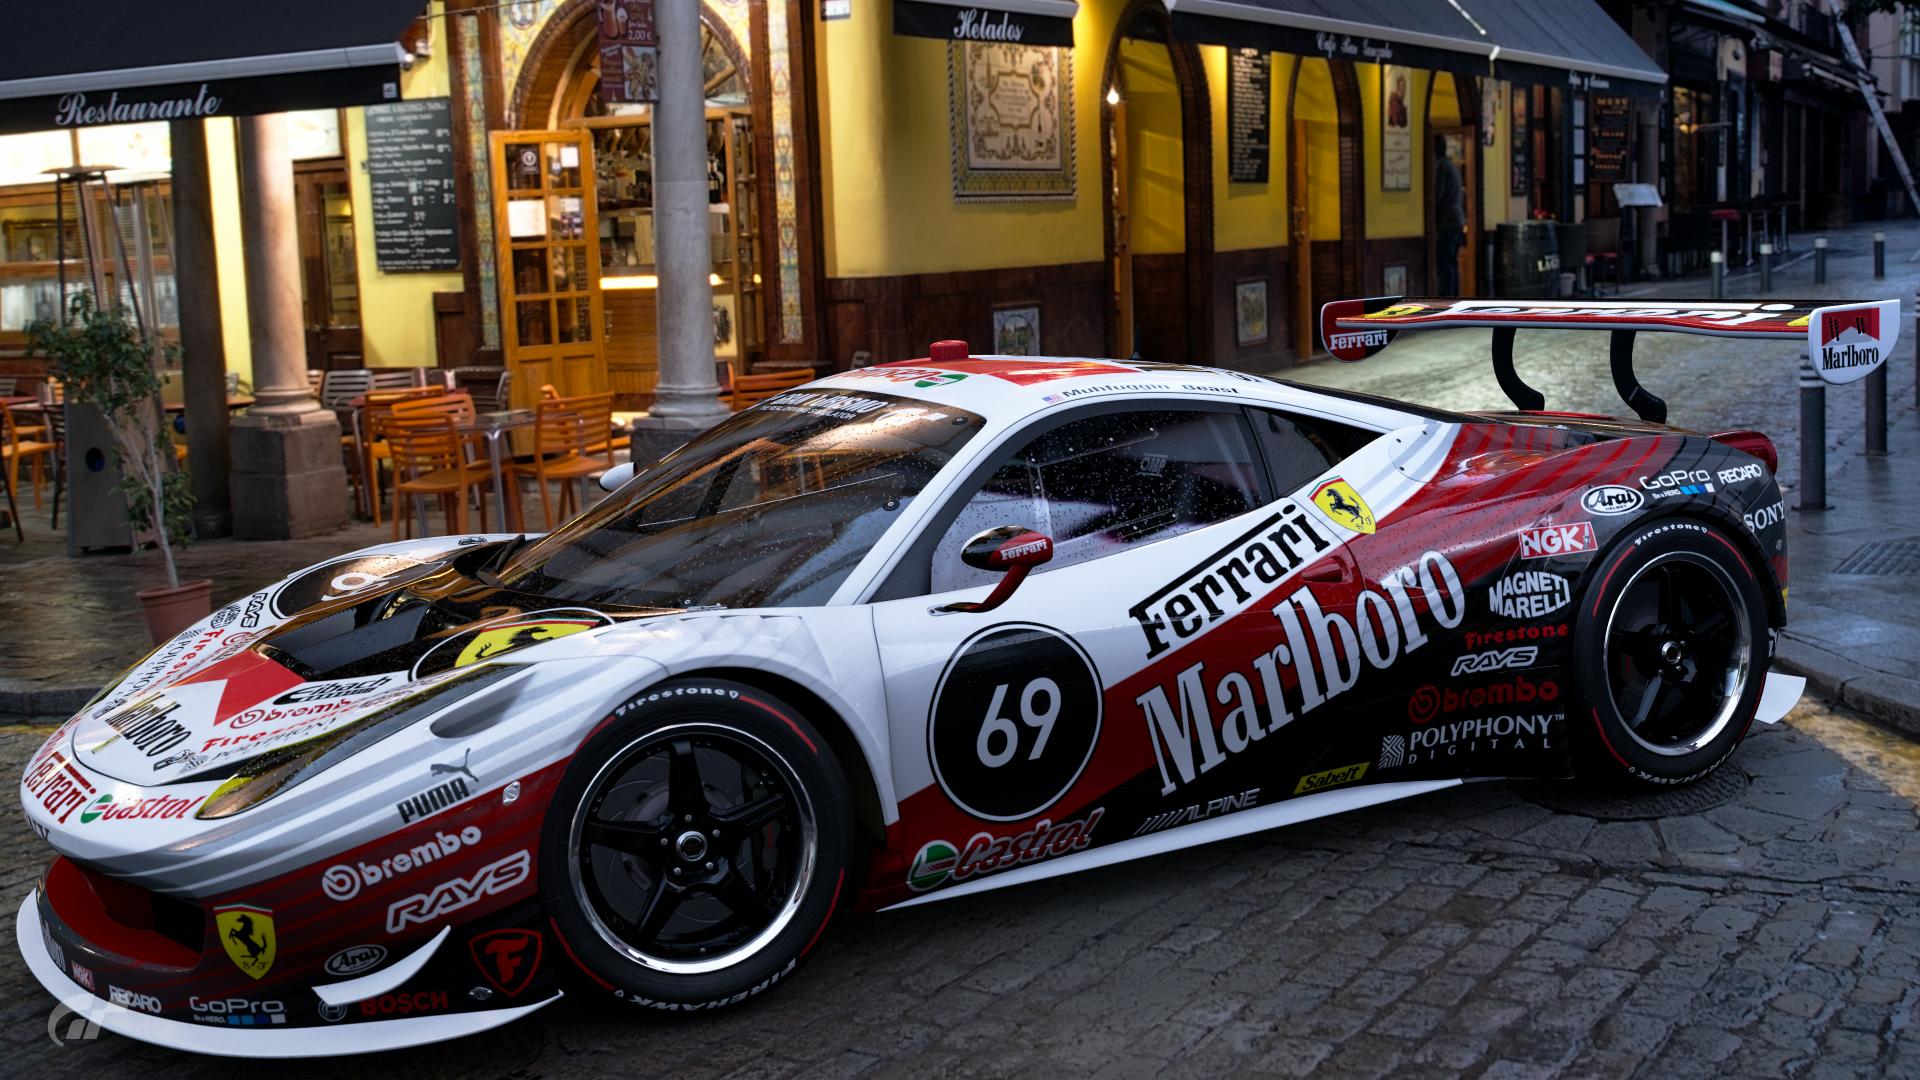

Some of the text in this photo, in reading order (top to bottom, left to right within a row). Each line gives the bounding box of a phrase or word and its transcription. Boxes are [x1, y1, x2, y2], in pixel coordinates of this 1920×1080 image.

[953, 9, 1024, 41] Helados
[54, 83, 223, 126] Restaurante
[1329, 330, 1389, 351] Ferrari
[1821, 344, 1880, 371] Marlboro
[1062, 382, 1240, 398] Muhfuggin Beast
[1639, 469, 1711, 490] GoPro
[1717, 463, 1762, 485] RECARO
[1588, 488, 1635, 509] Arai
[1743, 500, 1787, 534] SONY
[1522, 525, 1581, 557] NGK
[1634, 520, 1699, 547] Firestone
[1000, 538, 1048, 562] Ferrari
[1129, 504, 1332, 660] Ferrari
[1489, 571, 1570, 602] MAGNETI
[241, 592, 268, 628] RAYS
[1489, 592, 1570, 619] MARELLI
[1464, 622, 1569, 651] Firestone
[1136, 550, 1466, 798] Marlboro
[1450, 646, 1539, 677] RAYS
[273, 676, 393, 705] Eibach
[615, 686, 726, 717] Firestone
[1442, 676, 1560, 713] brembo
[976, 677, 1062, 768] 69
[1409, 713, 1555, 751] POLYPHONY
[23, 751, 98, 826] Ferrari
[1302, 764, 1361, 794] Sabelt
[101, 794, 208, 822] Castrol
[397, 776, 471, 825] PUMA
[1174, 788, 1262, 823] ALPINE
[362, 825, 483, 886] brembo
[951, 806, 1106, 881] Castrol
[386, 849, 532, 934] RAYS
[330, 947, 379, 973] Arai
[108, 984, 162, 1014] RECARO
[630, 957, 799, 1012] FIREHAWK
[189, 995, 286, 1014] GoPro
[360, 990, 450, 1017] BOSCH
